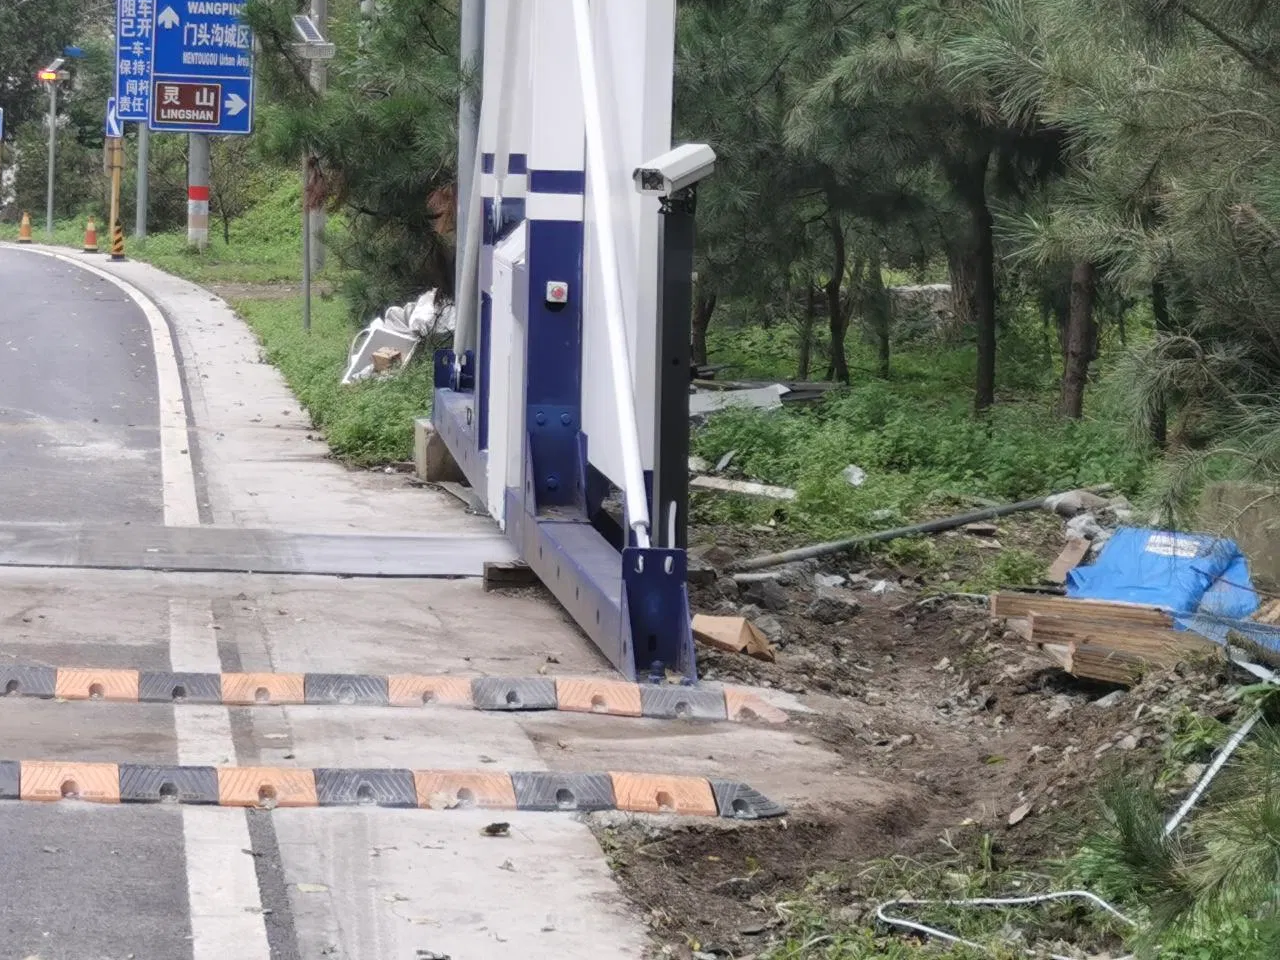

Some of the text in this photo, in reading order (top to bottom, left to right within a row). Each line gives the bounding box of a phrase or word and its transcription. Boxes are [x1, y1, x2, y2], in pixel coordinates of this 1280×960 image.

[183, 22, 250, 49] 门头沟城区
[120, 97, 149, 113] 责任
[163, 86, 215, 107] 灵山
[161, 108, 214, 121] LINGSHAN
